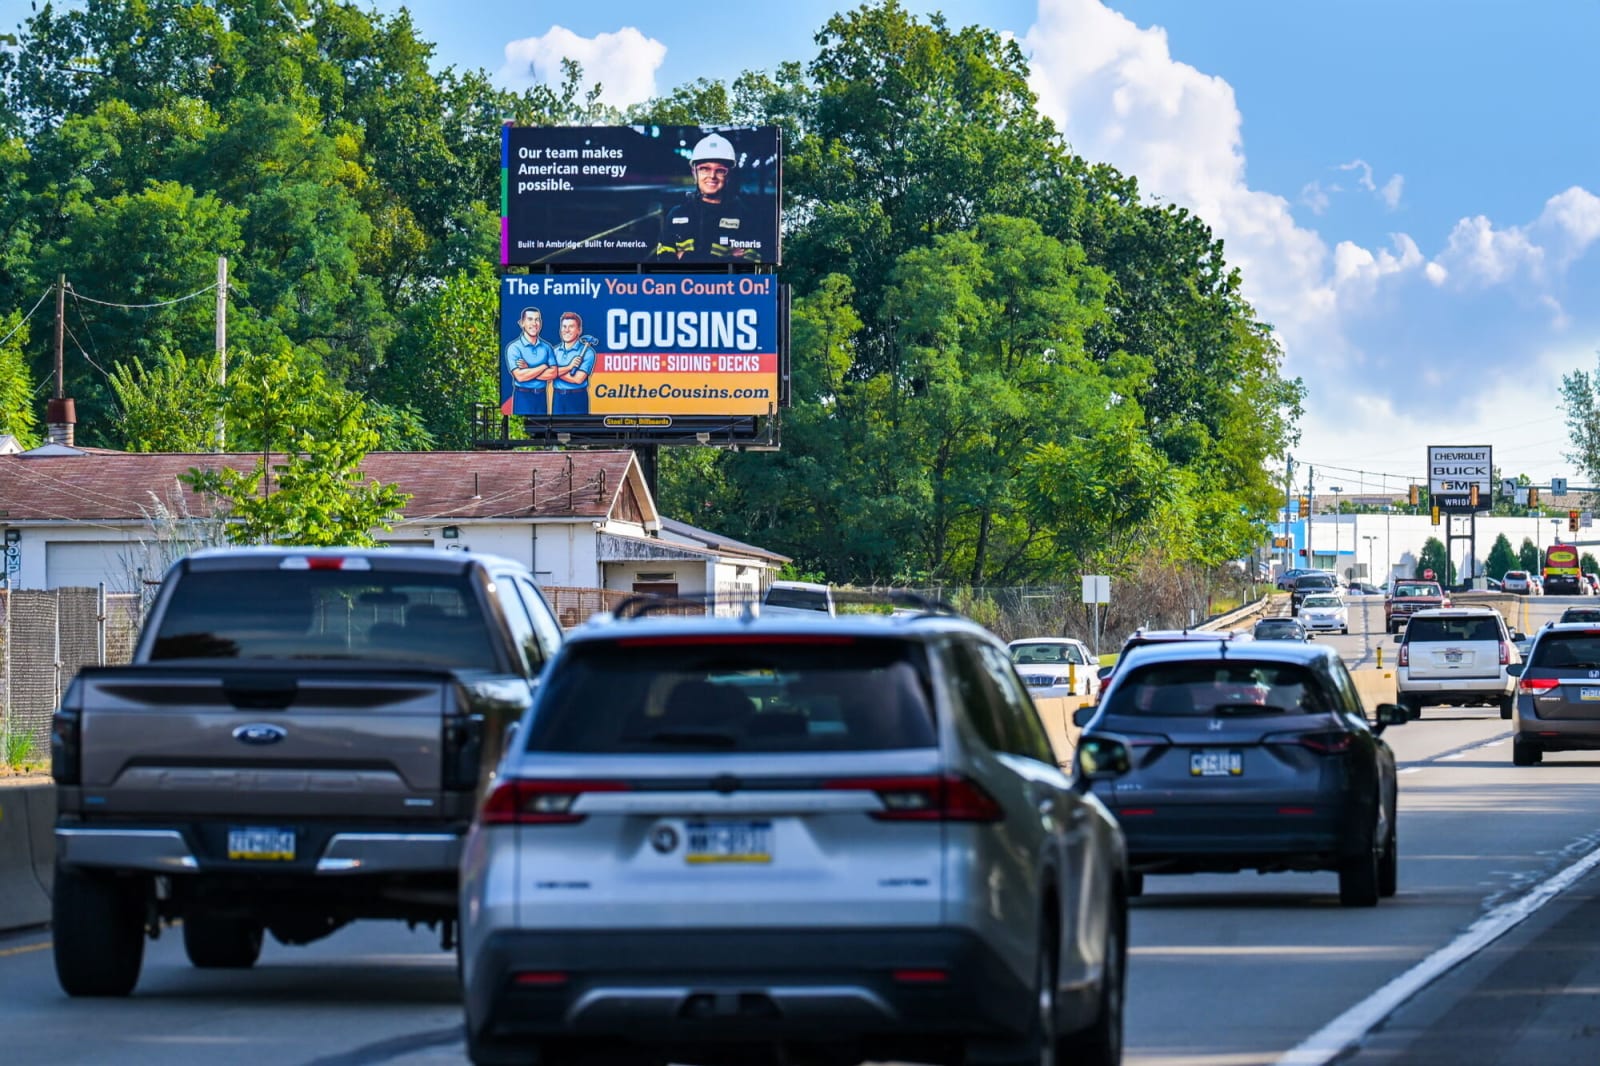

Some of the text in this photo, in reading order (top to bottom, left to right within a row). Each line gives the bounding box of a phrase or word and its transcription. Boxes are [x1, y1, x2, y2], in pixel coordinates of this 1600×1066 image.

[519, 146, 623, 159] Our team makes
[518, 163, 627, 178] American energy
[518, 179, 574, 194] possible.
[518, 241, 648, 250] Built in Ambridge. Built for America.
[729, 239, 762, 249] Tenaris
[506, 278, 770, 299] The Family You Can Count On!
[606, 308, 758, 351] COUSINS
[604, 356, 760, 372] ROOFING SIDING DECKS
[594, 383, 770, 400] CalltheCousins.com
[1434, 452, 1486, 461] CHEVROLET
[1433, 467, 1487, 475] BUICK
